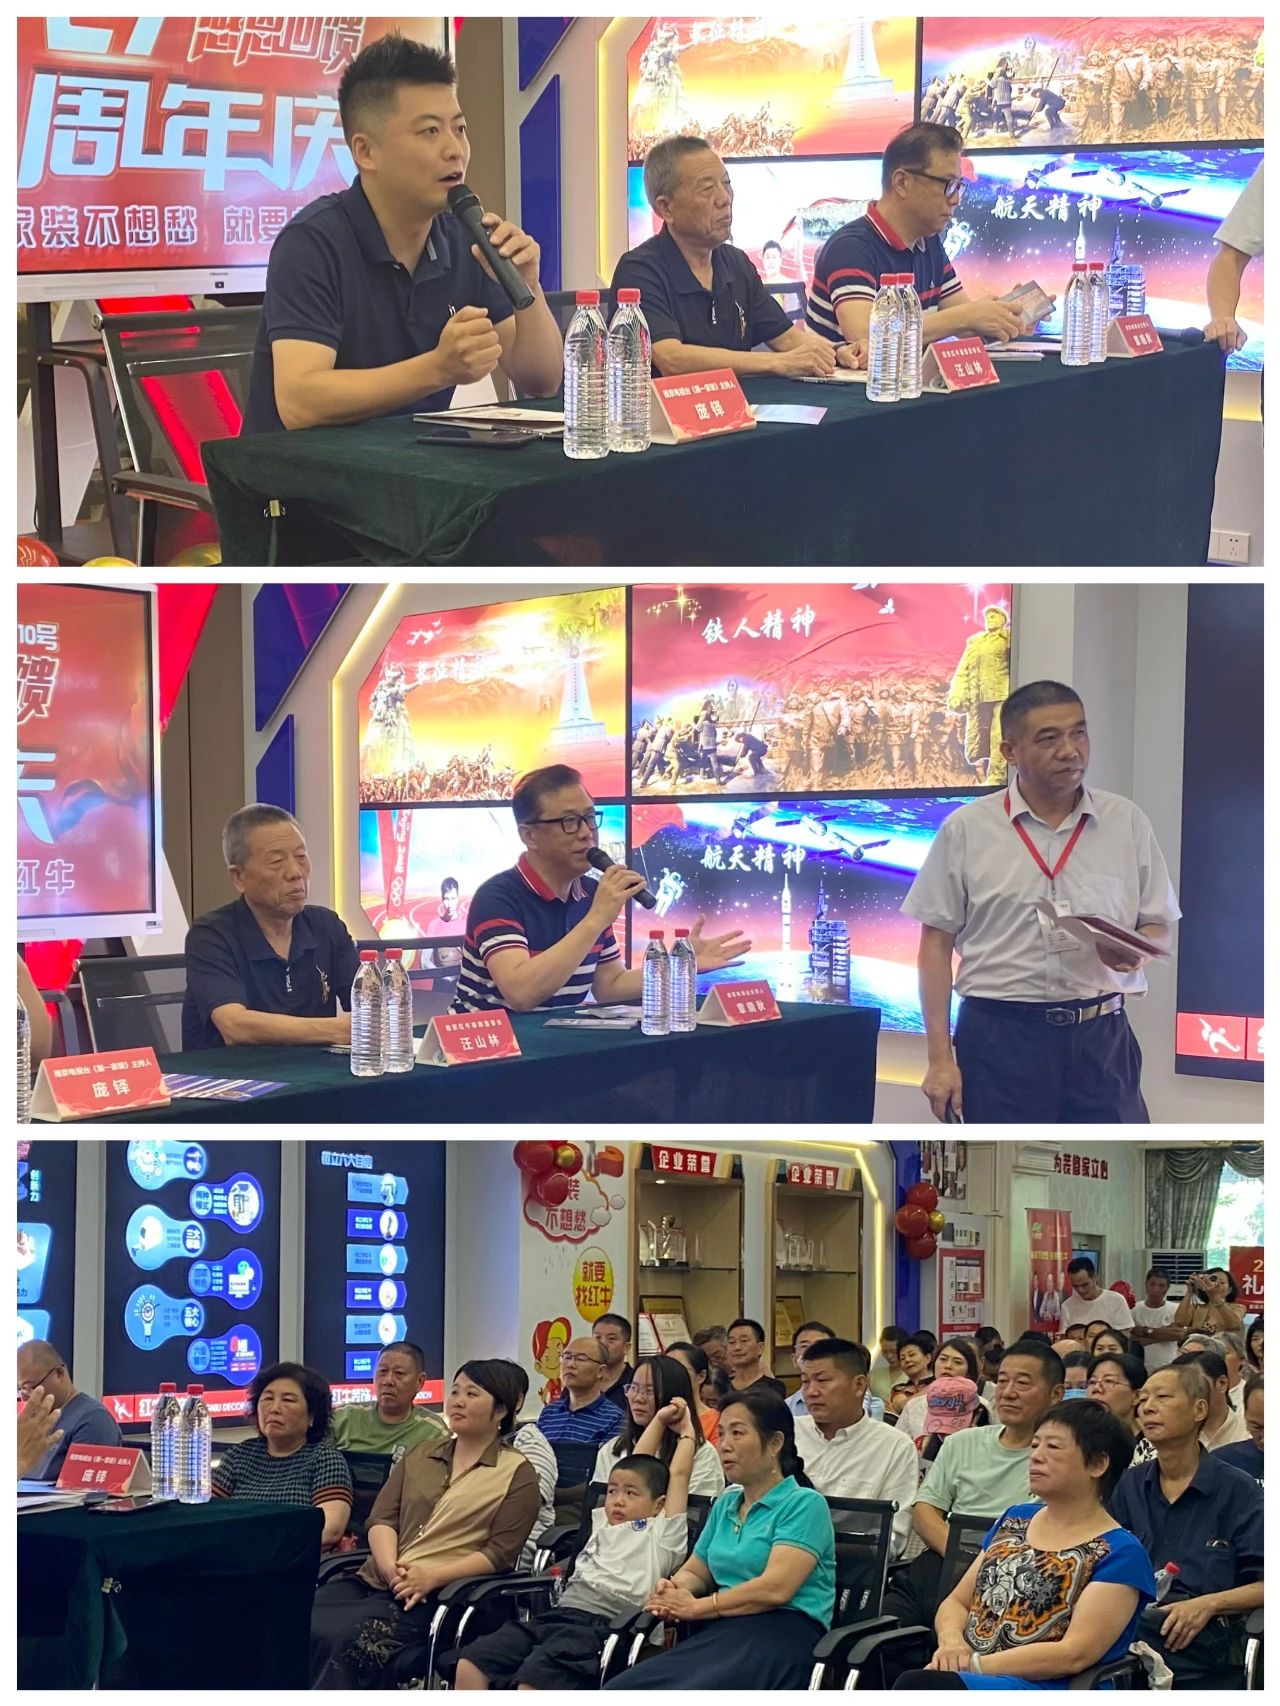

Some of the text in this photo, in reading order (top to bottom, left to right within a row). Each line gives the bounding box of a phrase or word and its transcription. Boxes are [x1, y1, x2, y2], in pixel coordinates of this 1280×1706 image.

[17, 72, 358, 191] 周年庆
[990, 193, 1103, 222] 航天精神
[953, 360, 984, 378] 汪山林
[701, 606, 817, 646] 铁人精神
[700, 846, 806, 874] 航天精神
[459, 1033, 501, 1051] 汪山林
[658, 1150, 712, 1174] 企业荣誉
[790, 1165, 835, 1187] 企业荣誉
[545, 1207, 587, 1232] 不想愁
[582, 1261, 606, 1283] 就要
[574, 1285, 611, 1307] 找红牛
[184, 1306, 200, 1317] 五大
